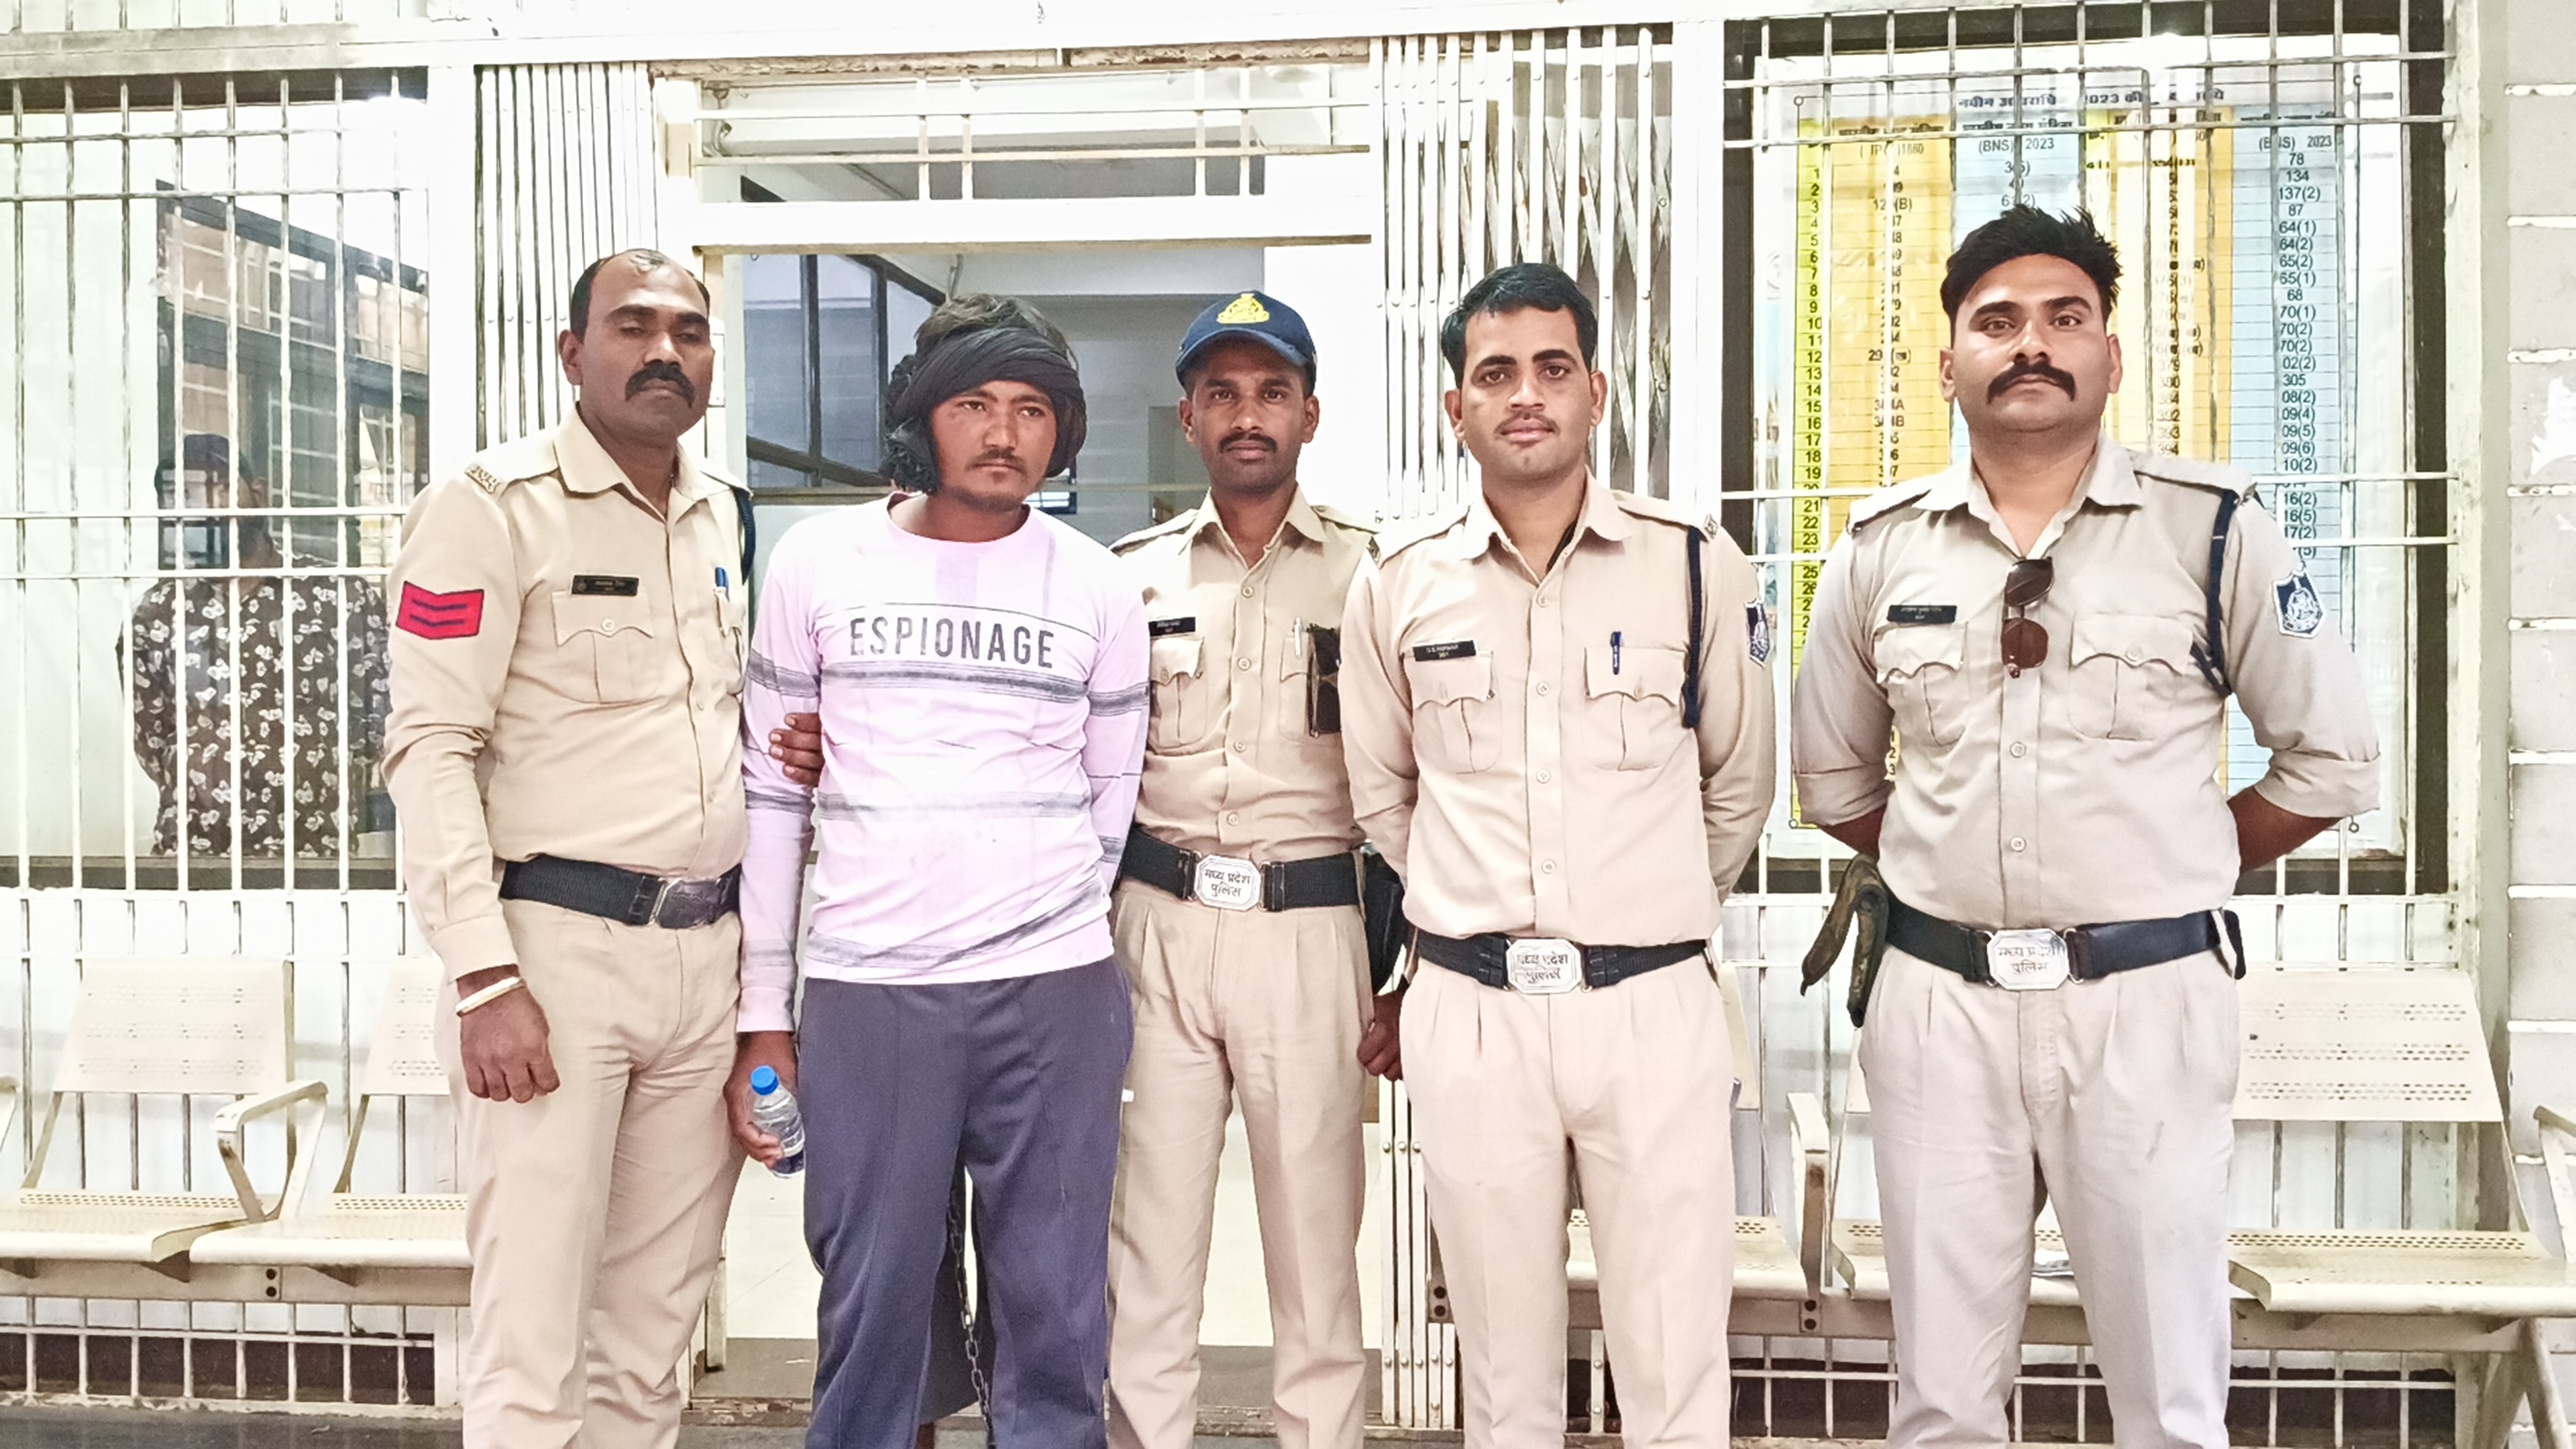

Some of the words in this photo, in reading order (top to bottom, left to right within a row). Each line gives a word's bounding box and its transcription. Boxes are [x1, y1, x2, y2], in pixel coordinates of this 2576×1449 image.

[2025, 138, 2055, 150] 2023
[2308, 135, 2332, 148] 2023
[2289, 153, 2304, 166] 78
[2286, 170, 2309, 182] 134
[1811, 183, 1820, 197] 2
[2279, 186, 2320, 202] 137(2)
[1811, 200, 1819, 213] 3
[2288, 204, 2304, 216] 87
[1811, 217, 1818, 227] 4
[2279, 220, 2316, 236] 64(1)
[1811, 234, 1819, 246] 5
[2279, 237, 2314, 254] 64(2)
[1810, 251, 1819, 263] 6
[2279, 254, 2314, 271] 65(2)
[1811, 268, 1817, 280] 7
[2279, 272, 2316, 288] 65(1)
[1809, 284, 1818, 297] 8
[2287, 289, 2303, 301] 68
[1809, 301, 1817, 313] 9
[2280, 305, 2316, 321] 70(1)
[1807, 317, 1822, 329] 10
[2280, 322, 2313, 338] 70(2)
[1808, 335, 1822, 346] 11
[2280, 339, 2313, 355] 70(2)
[1807, 351, 1822, 363] 12
[2283, 356, 2316, 372] 02(2)
[1807, 368, 1822, 380] 13
[2282, 374, 2306, 386] 305
[1807, 384, 1821, 396] 14
[2282, 390, 2316, 407] 08(2)
[1807, 400, 1821, 413] 15
[2282, 407, 2315, 423] 09(4)
[1807, 417, 1821, 429] 16
[2282, 424, 2315, 440] 09(5)
[1806, 434, 1821, 446] 17
[2282, 441, 2315, 457] 09(6)
[1806, 450, 1821, 463] 18
[1806, 466, 1821, 479] 19
[2284, 458, 2318, 475] 10(2)
[1803, 500, 1819, 513] 21
[2284, 492, 2317, 508] 16(2)
[1803, 516, 1819, 529] 22
[2284, 509, 2317, 525] 16(5)
[1803, 532, 1819, 545] 23
[2284, 526, 2317, 539] 17(2)
[1803, 566, 1819, 579] 25
[849, 615, 1055, 669] ESPIONAGE
[1204, 869, 1226, 880] मध्य
[1227, 870, 1252, 885] प्रदेश
[1210, 881, 1242, 898] पुलिस
